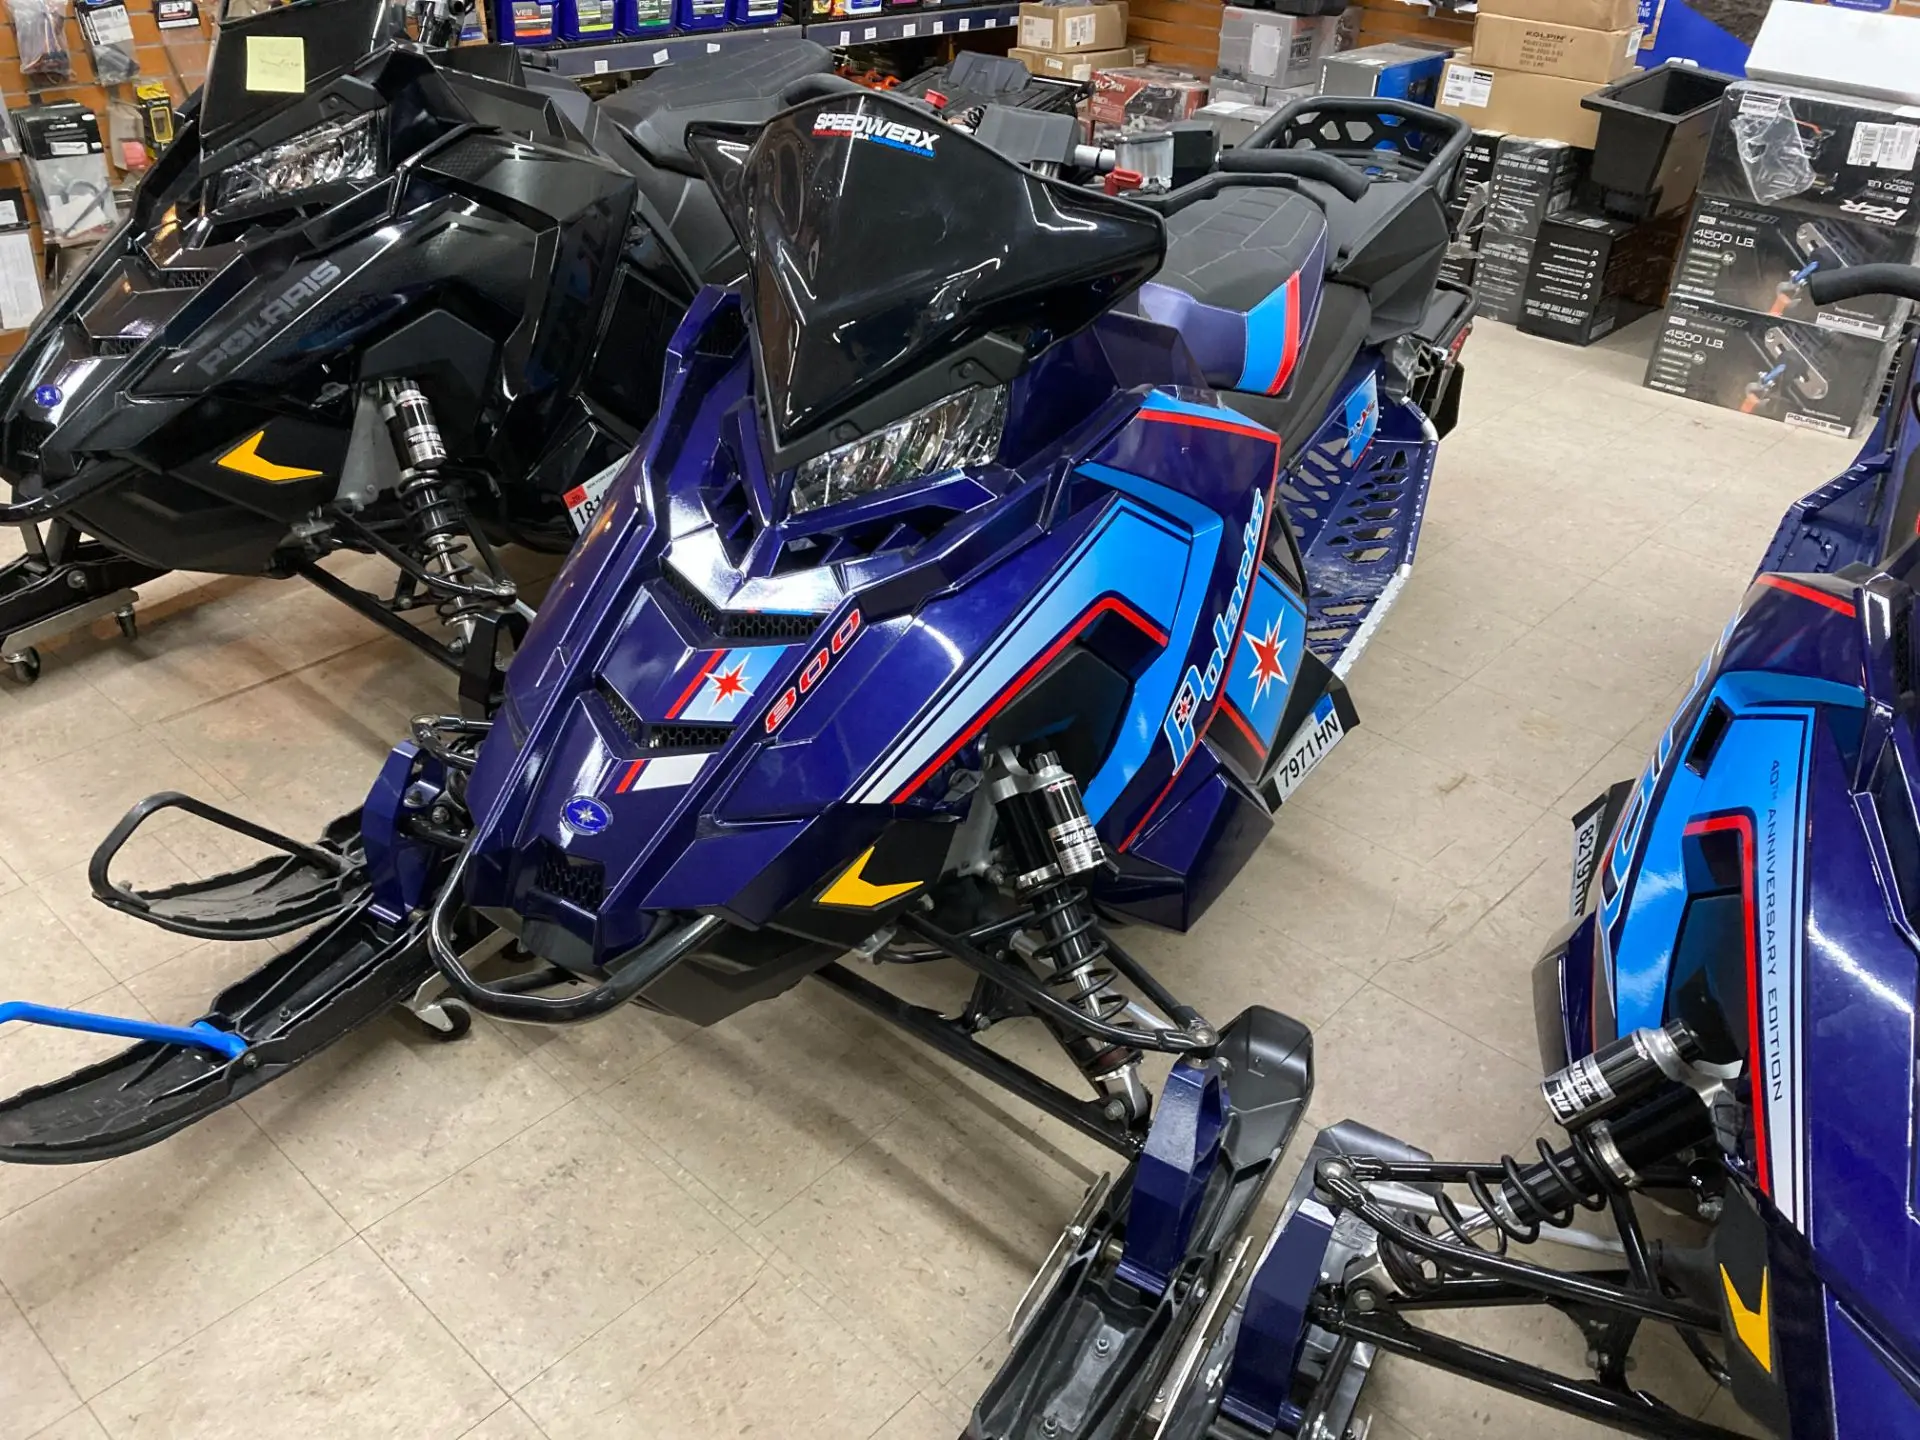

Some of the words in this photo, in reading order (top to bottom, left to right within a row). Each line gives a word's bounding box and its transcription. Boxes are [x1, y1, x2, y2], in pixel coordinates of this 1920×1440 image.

[813, 112, 940, 151] SPEEDWERX
[1839, 199, 1908, 221] RZR
[1692, 237, 1721, 249] WINCH
[1694, 228, 1733, 244] 4500
[197, 259, 341, 377] POLARIS
[1818, 313, 1860, 328] POLARIS
[1663, 336, 1692, 349] WINCH
[1664, 328, 1703, 345] 4500
[1786, 412, 1829, 428] POLARIS
[1164, 487, 1265, 777] Polaris
[765, 608, 861, 734] 800
[1765, 808, 1778, 976] ANNIVERSARY
[1767, 986, 1784, 1102] EDITION
